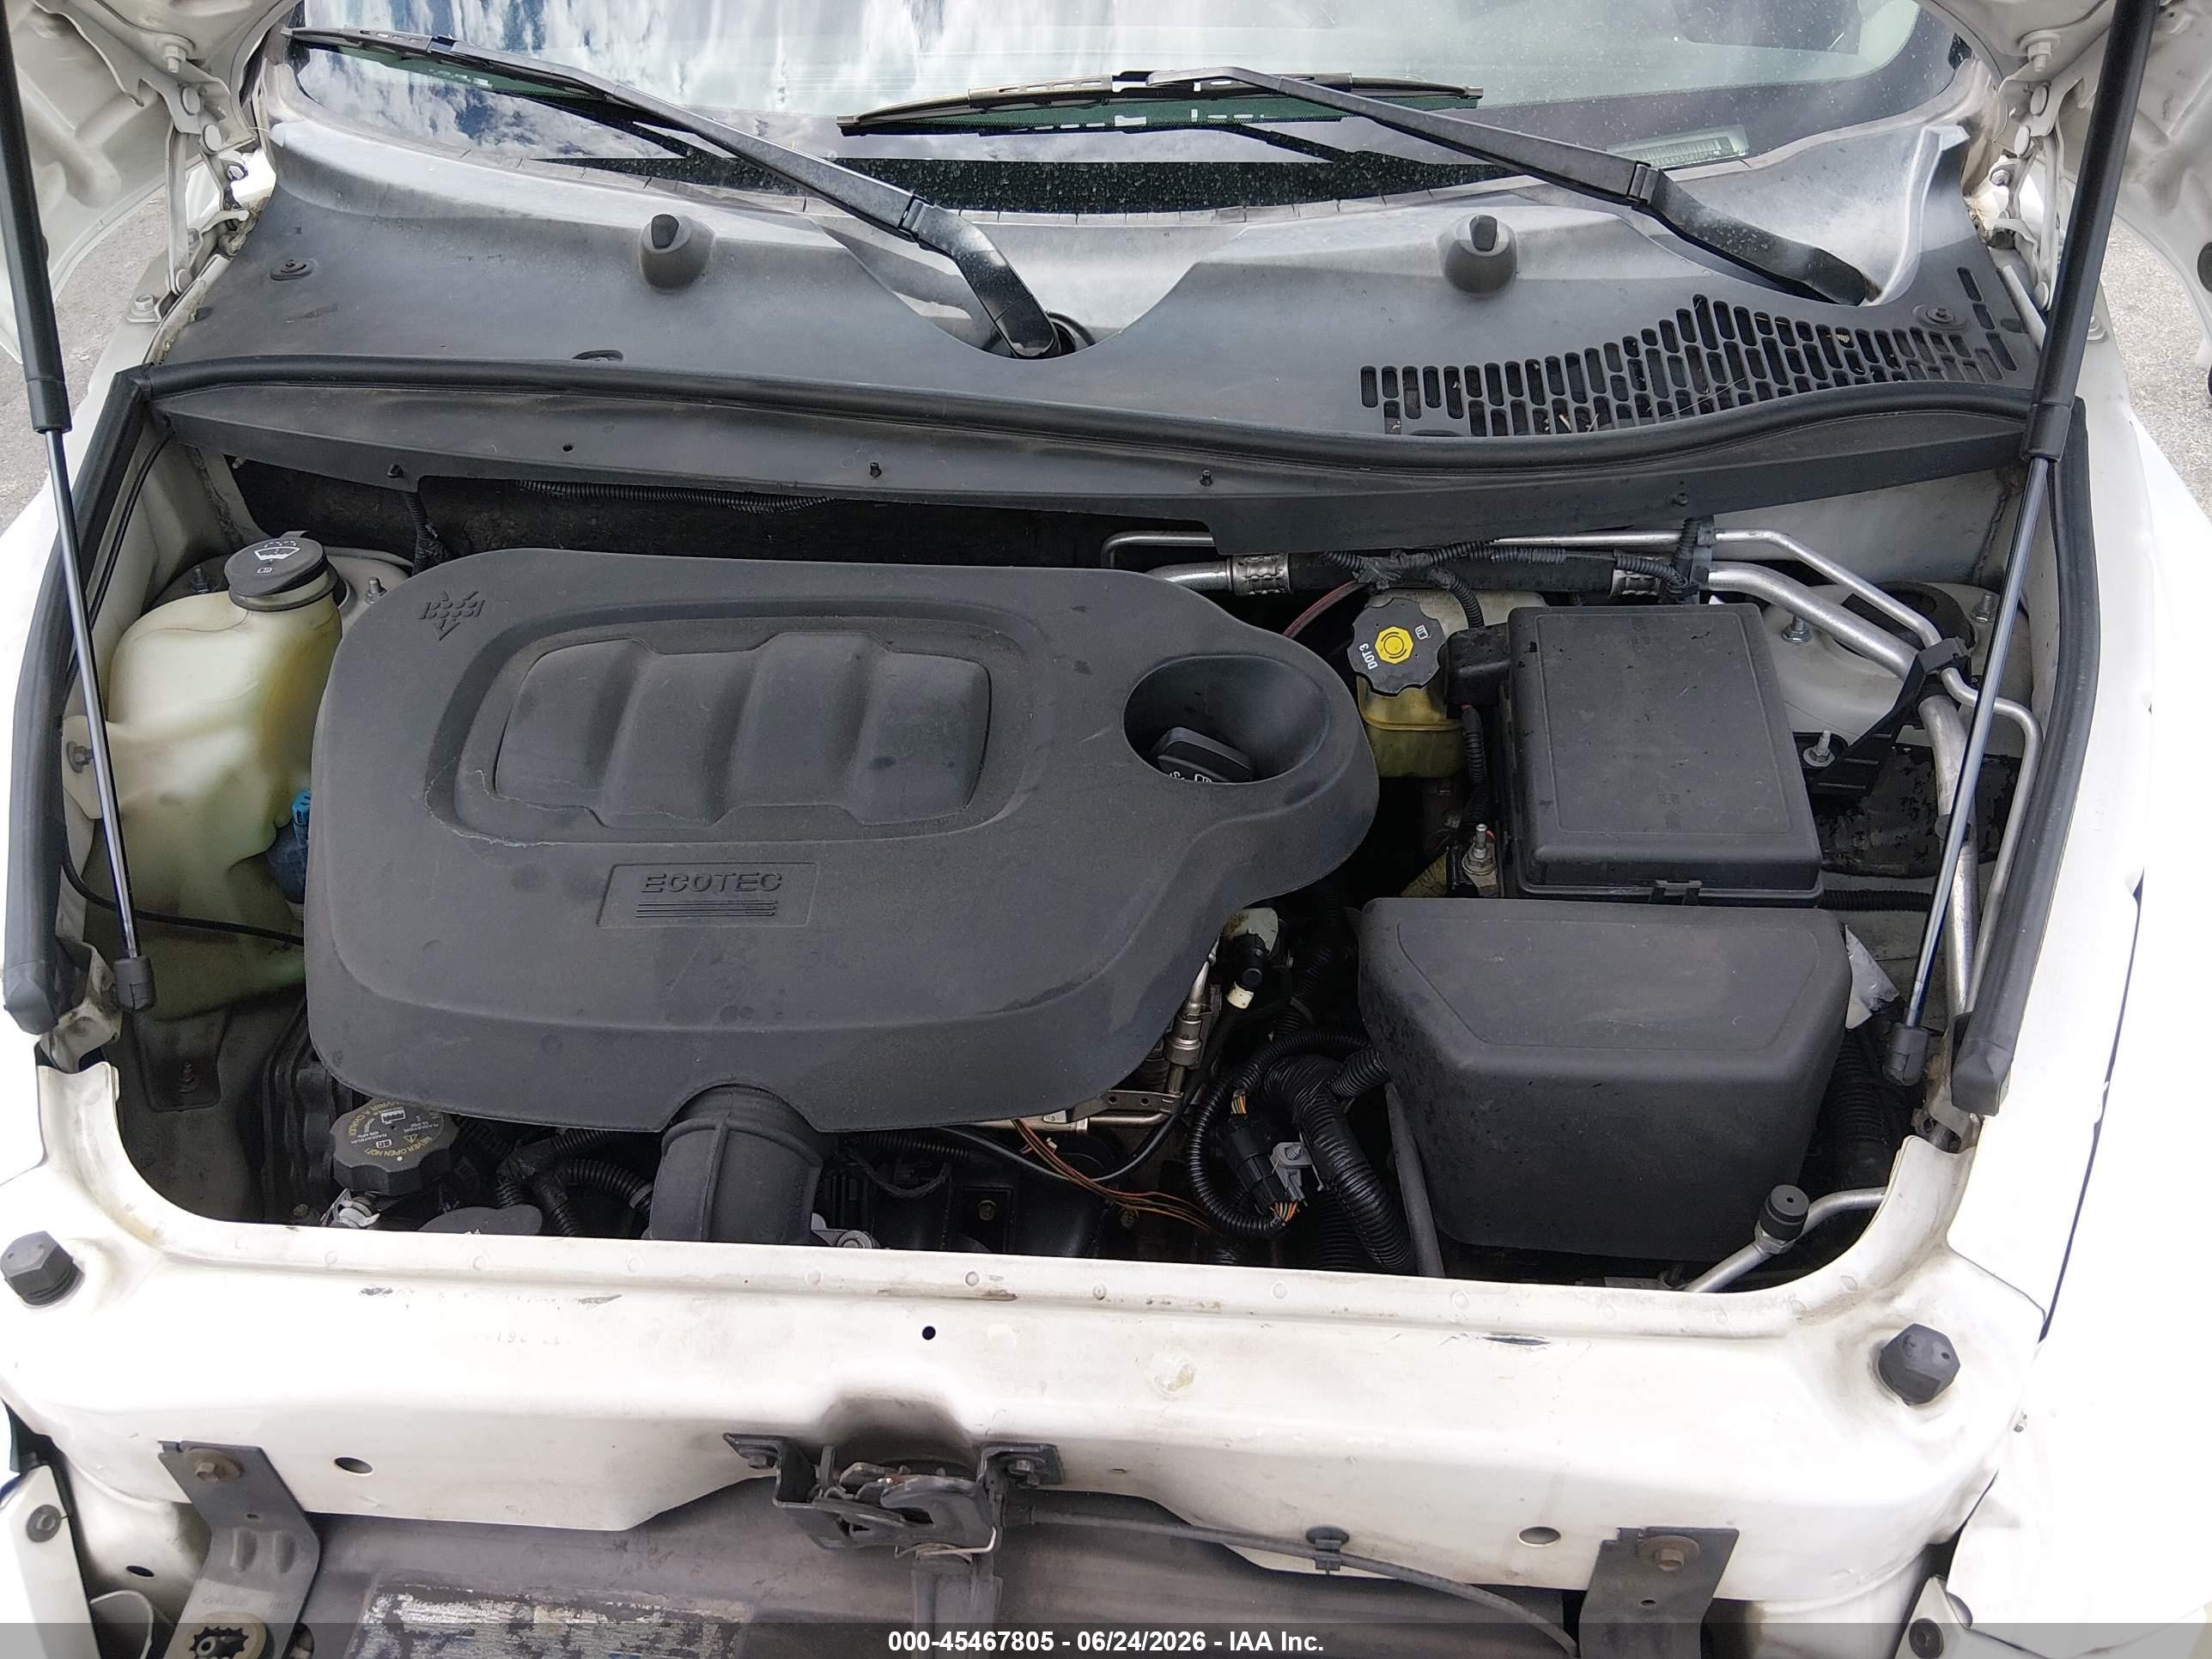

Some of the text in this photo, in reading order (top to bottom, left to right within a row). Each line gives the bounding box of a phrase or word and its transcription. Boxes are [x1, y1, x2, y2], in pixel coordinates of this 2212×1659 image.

[641, 872, 782, 892] ECOTEC
[407, 1136, 433, 1152] NEVER
[384, 1148, 407, 1157] OPEN
